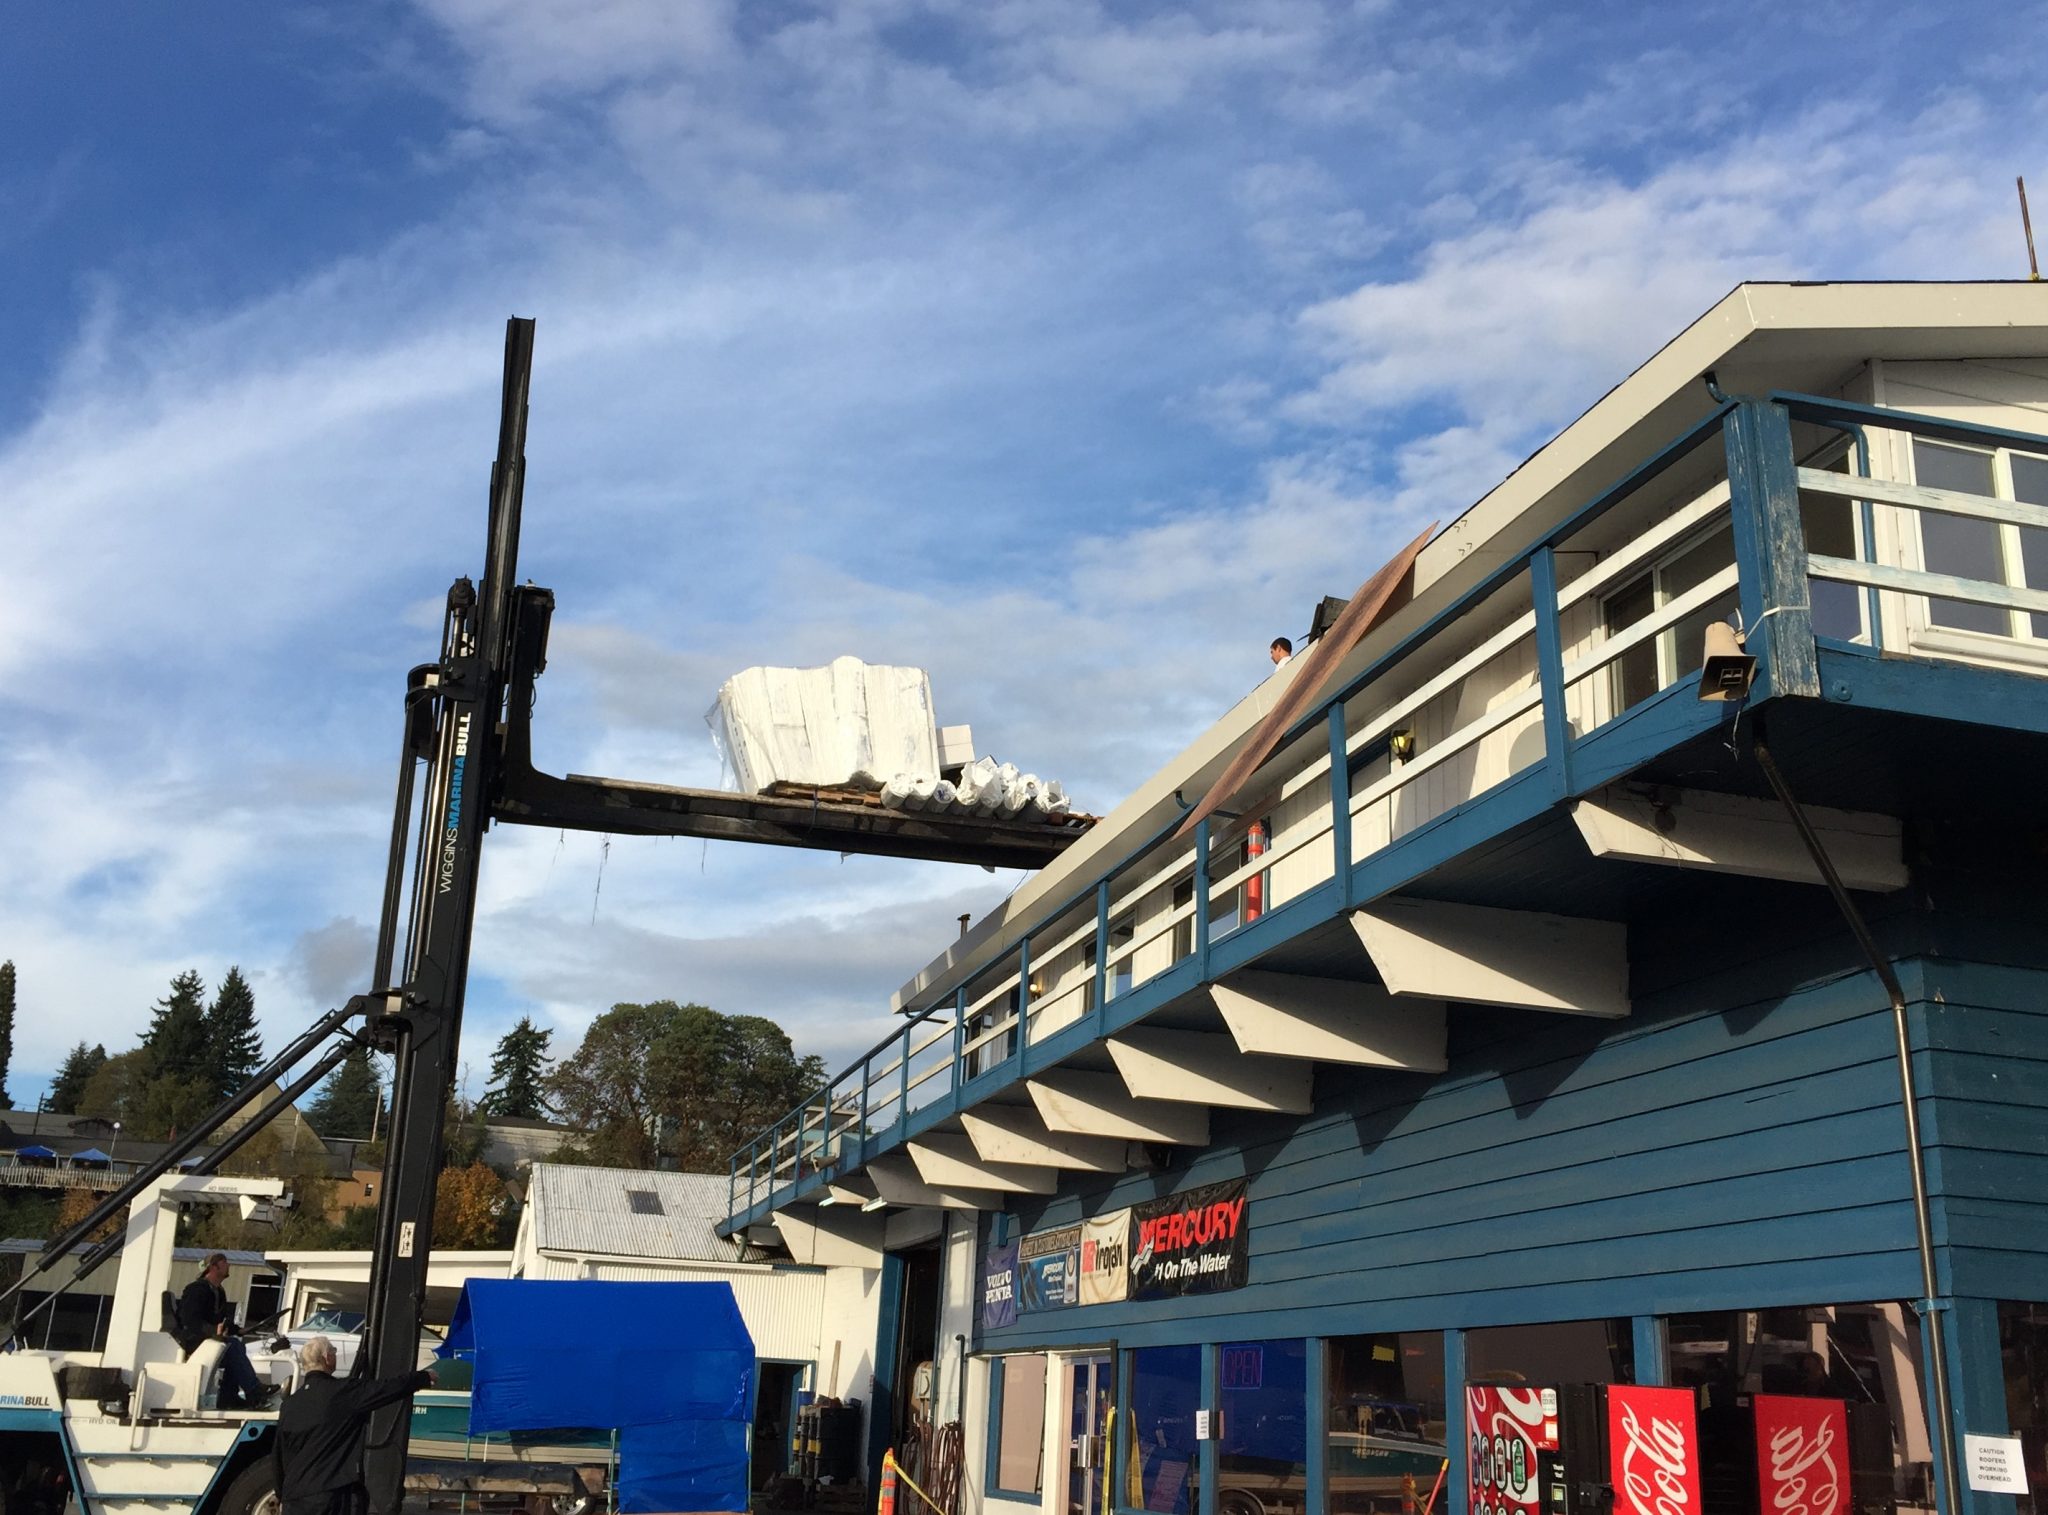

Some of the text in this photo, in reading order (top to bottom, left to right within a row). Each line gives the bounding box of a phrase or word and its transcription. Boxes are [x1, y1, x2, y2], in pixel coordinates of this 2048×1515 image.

[1137, 1197, 1246, 1255] MERCURY
[1095, 1237, 1122, 1277] Trojan
[1164, 1260, 1179, 1280] On
[1180, 1257, 1199, 1278] The
[1200, 1253, 1232, 1274] Water
[987, 1269, 1012, 1289] VOLVO
[985, 1285, 1012, 1304] PENTA
[1223, 1349, 1261, 1386] OPEN
[1978, 1447, 2005, 1455] CAUTION
[1978, 1456, 2007, 1465] ROOFERS
[1977, 1474, 2012, 1483] OVERHEAD
[1979, 1465, 2008, 1473] WORKING
